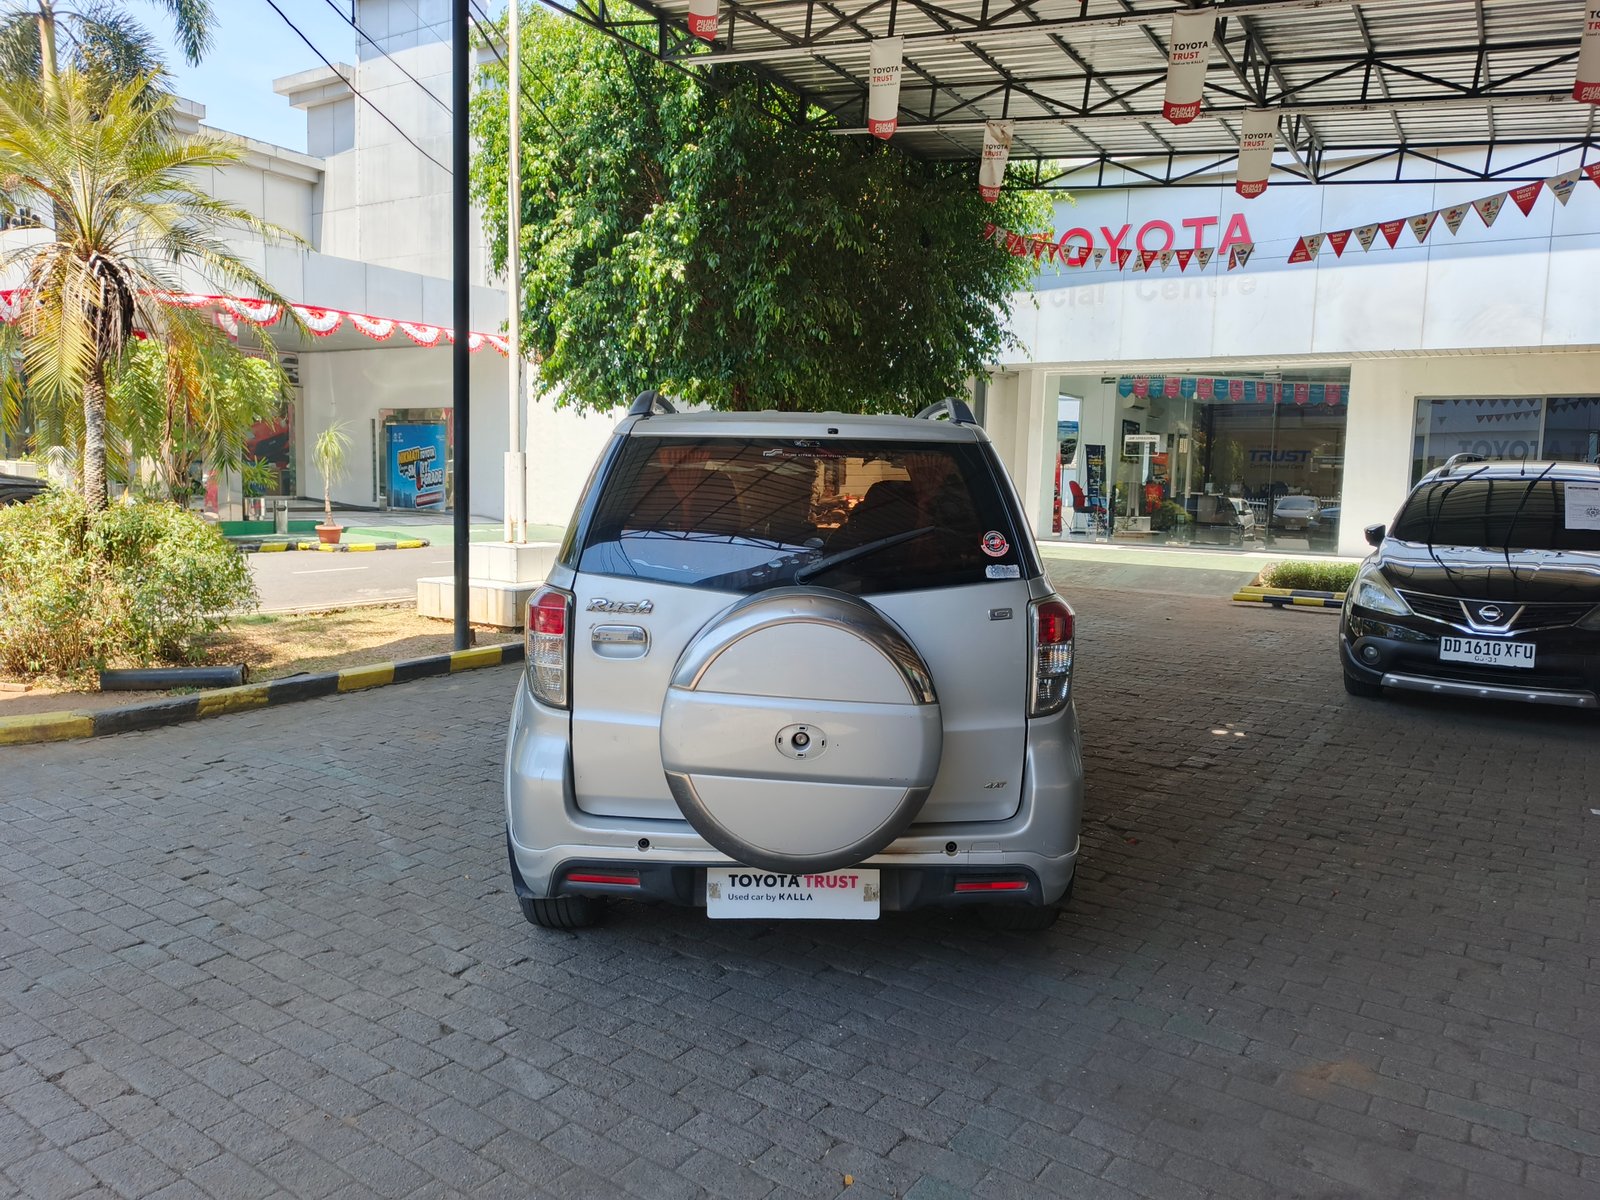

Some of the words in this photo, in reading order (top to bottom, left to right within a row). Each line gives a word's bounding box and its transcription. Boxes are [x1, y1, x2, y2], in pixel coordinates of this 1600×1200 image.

[1174, 41, 1208, 51] TOYOTA
[1172, 51, 1199, 60] TRUST
[873, 66, 899, 74] TOYOTA
[873, 75, 893, 83] TRUST
[1582, 86, 1600, 94] PILI
[1244, 132, 1273, 140] TOYOTA
[1025, 213, 1256, 267] OYOTA
[1249, 449, 1311, 462] TRUST
[586, 598, 653, 613] Rush
[1443, 638, 1461, 652] DD
[1464, 641, 1501, 656] 1610
[1504, 643, 1533, 659] XFU
[728, 874, 800, 888] TOYOTA
[804, 875, 859, 889] TRUST
[728, 892, 749, 901] Used
[766, 893, 776, 903] by
[778, 893, 813, 901] KALLA
